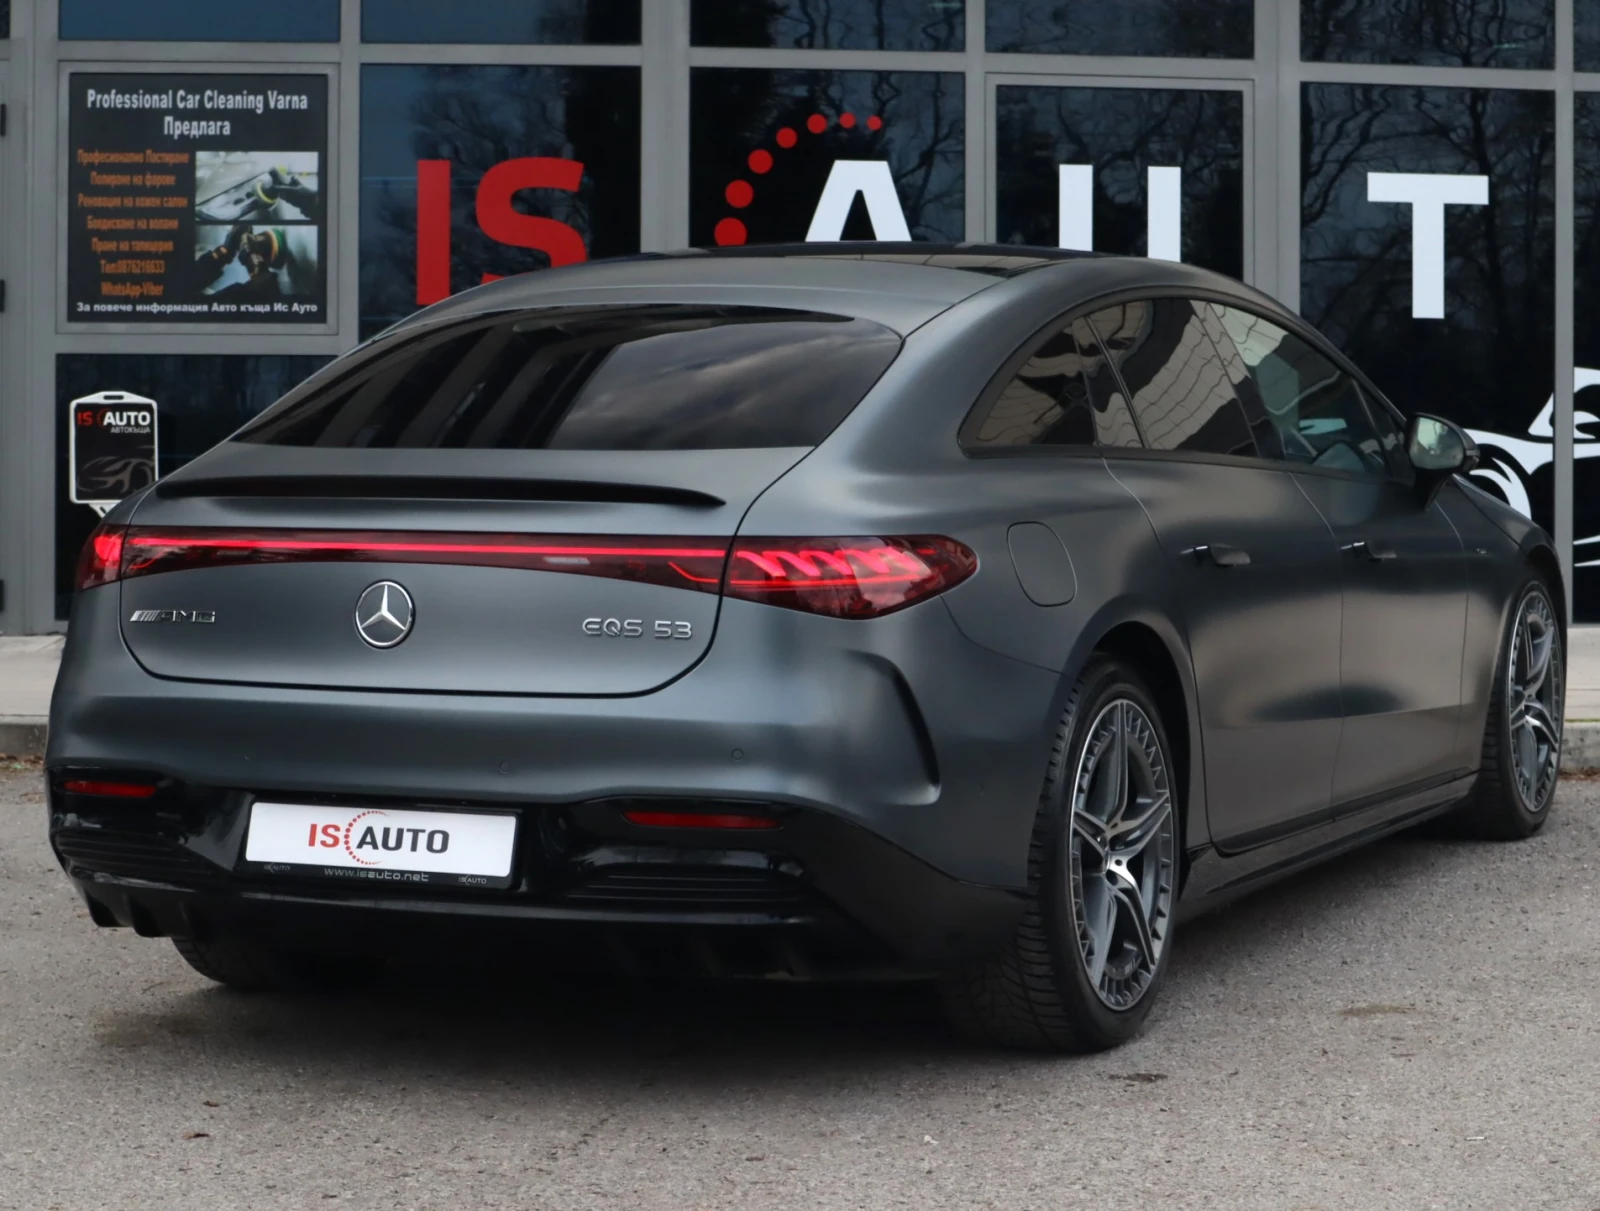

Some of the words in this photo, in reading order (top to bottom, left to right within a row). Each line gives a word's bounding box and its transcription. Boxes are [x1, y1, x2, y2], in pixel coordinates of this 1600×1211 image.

[86, 89, 173, 109] Professional
[176, 90, 200, 109] Car
[204, 90, 264, 114] Cleaning
[267, 91, 308, 110] Varna
[163, 115, 231, 140] Предлага
[416, 156, 588, 306] IS
[77, 302, 91, 312] За
[93, 303, 133, 313] повече
[135, 302, 209, 314] информация
[211, 302, 238, 312] Авто
[240, 303, 271, 314] къща
[273, 302, 289, 312] Ис
[291, 302, 318, 314] Ауто
[77, 411, 94, 426] IS
[103, 411, 151, 426] AUTO
[582, 618, 643, 637] EQS
[654, 620, 692, 639] 53
[307, 823, 341, 848] IS
[355, 826, 450, 854] AUTO
[323, 867, 430, 882] www.isauto.net
